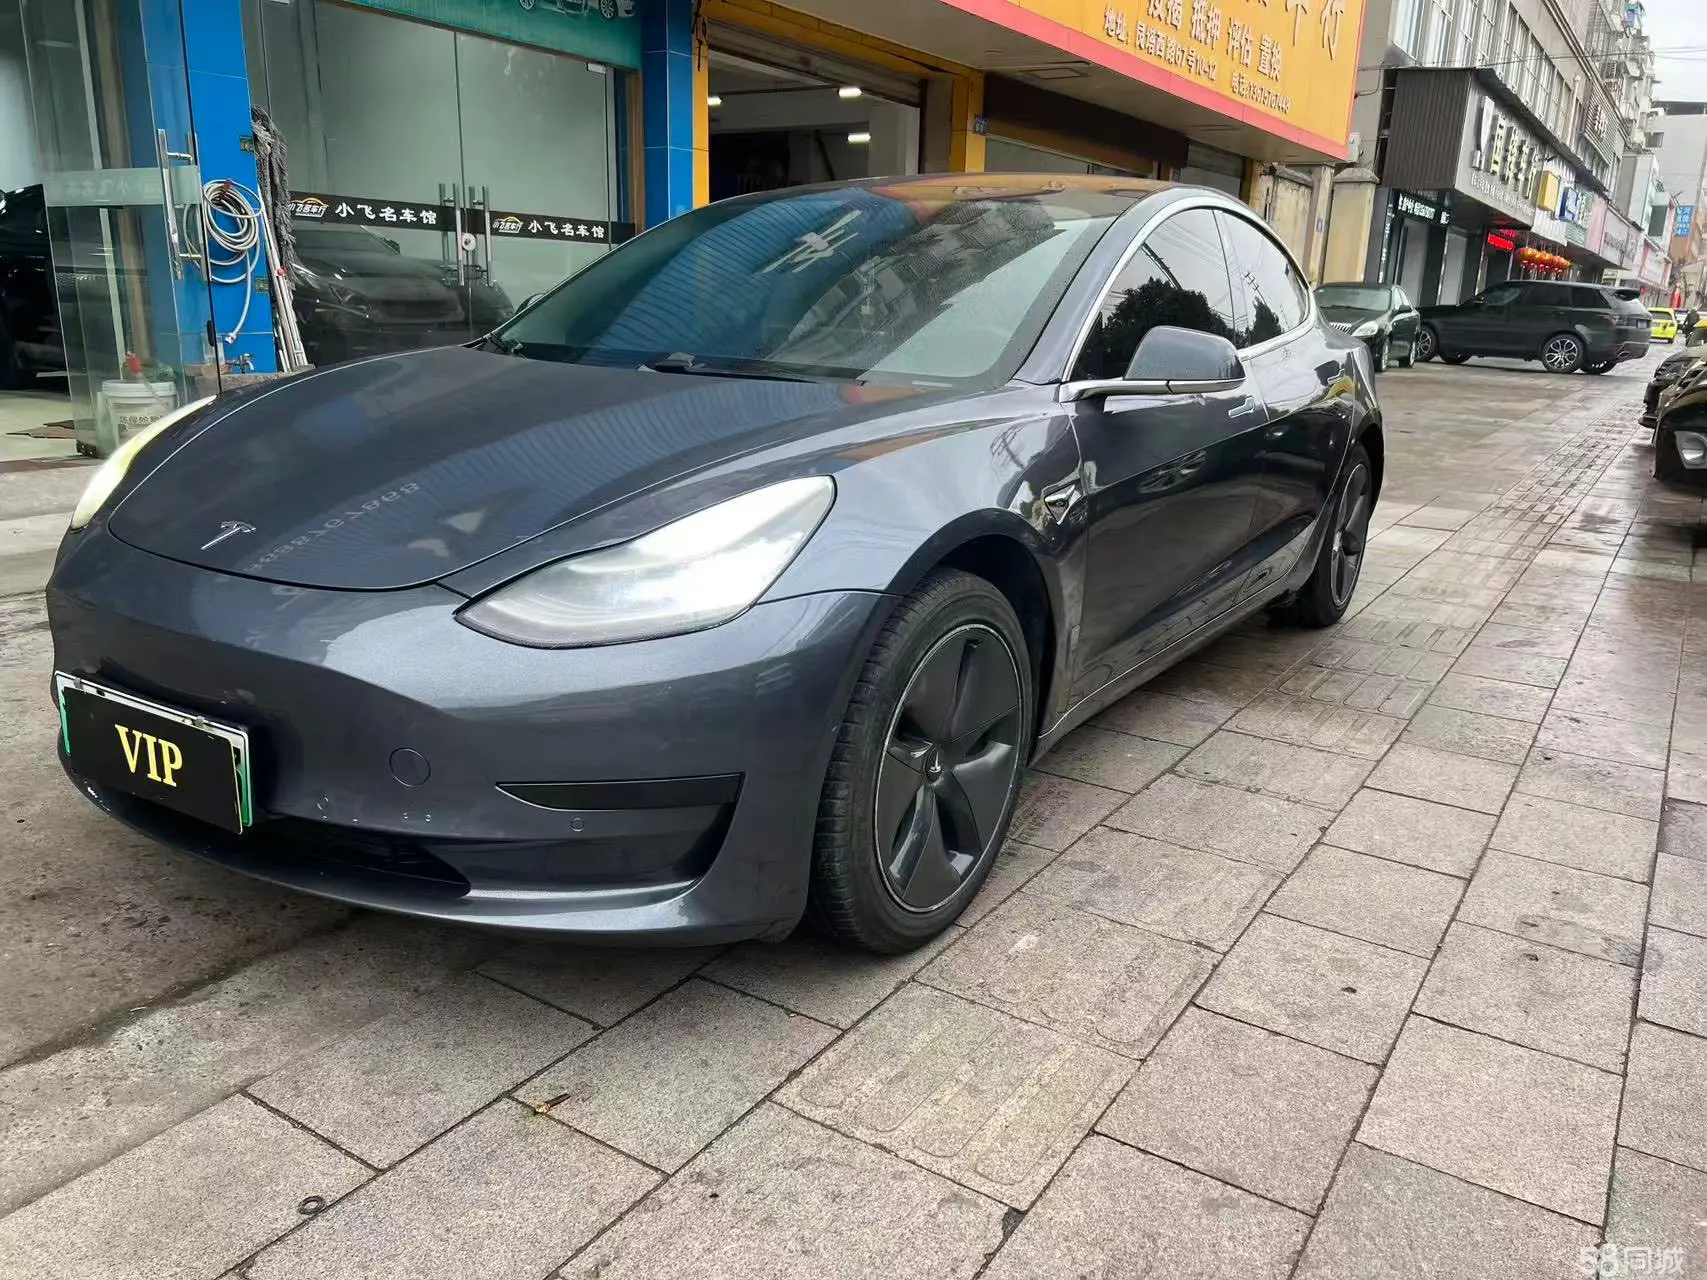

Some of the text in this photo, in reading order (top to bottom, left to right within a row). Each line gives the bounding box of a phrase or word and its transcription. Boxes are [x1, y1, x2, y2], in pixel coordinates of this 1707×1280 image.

[1227, 17, 1254, 68] 评估
[1259, 33, 1282, 81] 置换
[334, 202, 437, 225] 小飞名车馆
[528, 219, 605, 238] 小飞名车馆
[114, 723, 183, 788] VIP
